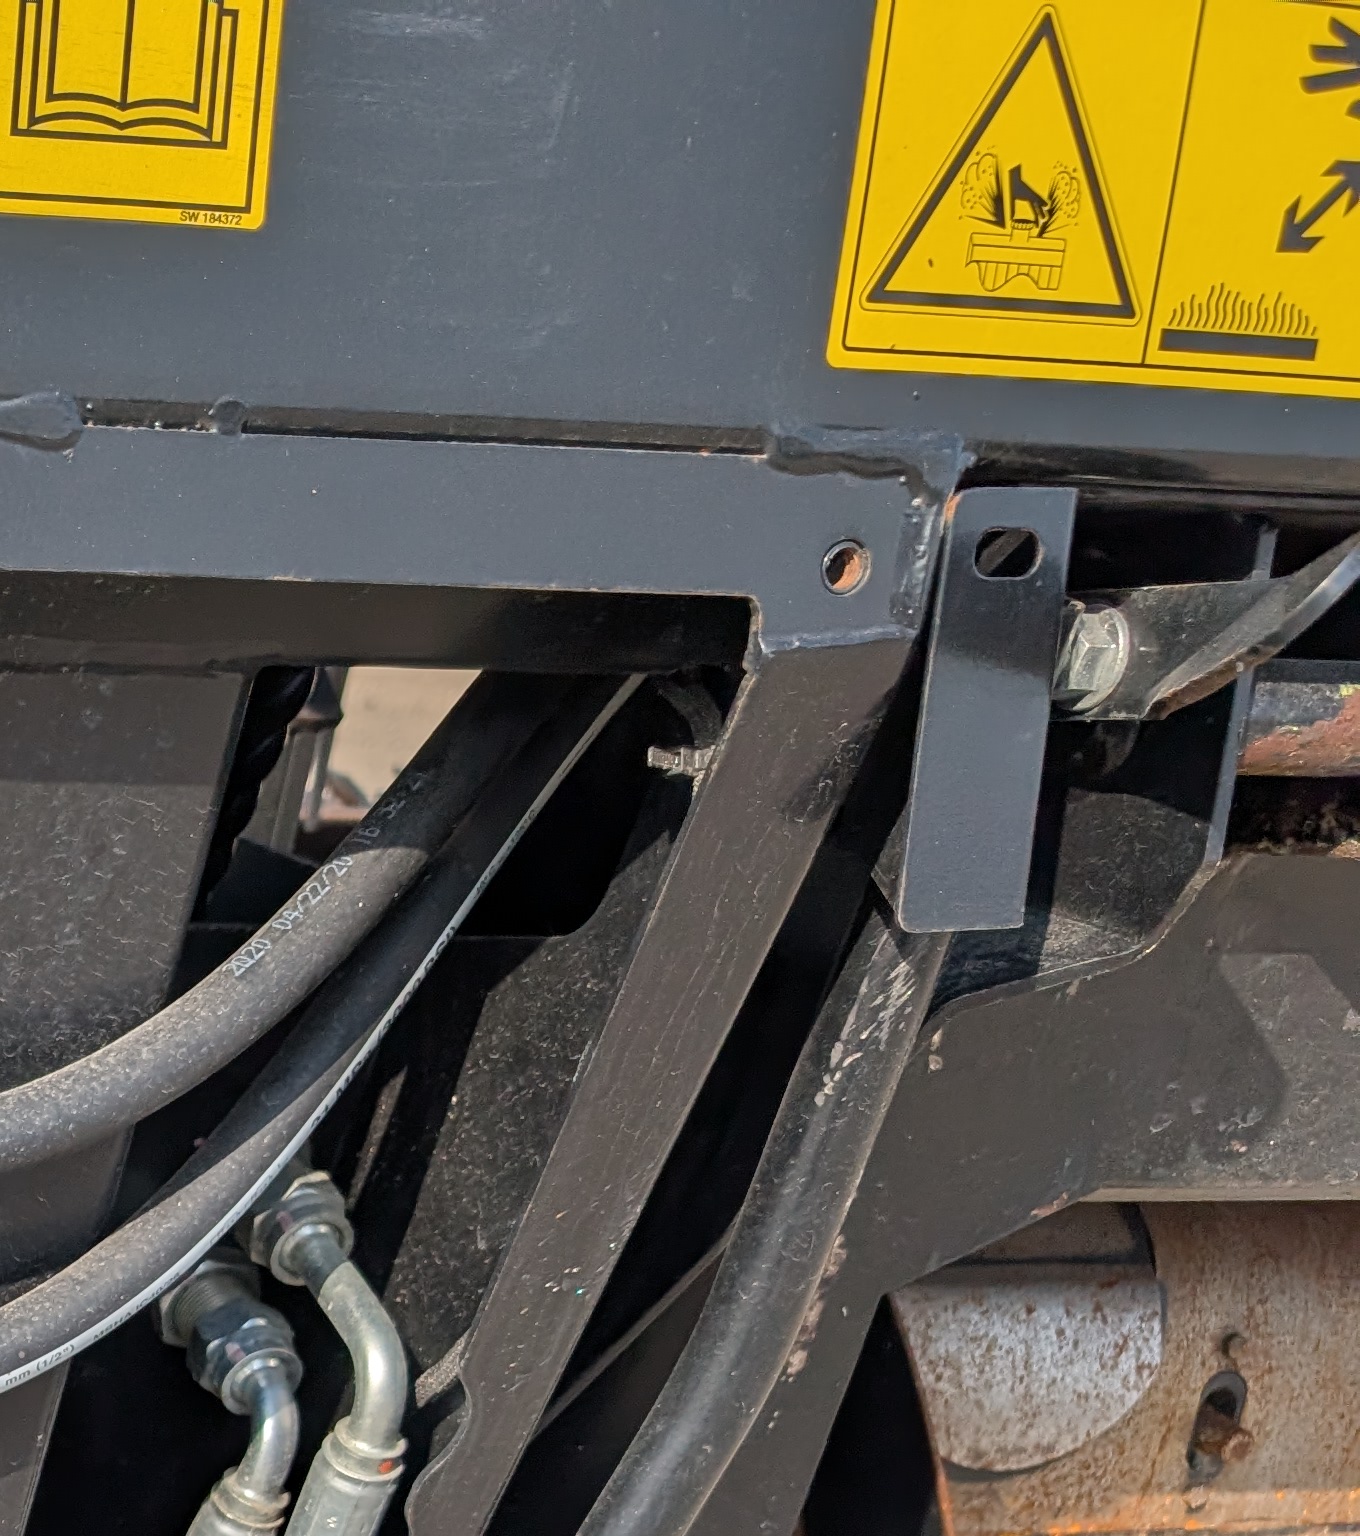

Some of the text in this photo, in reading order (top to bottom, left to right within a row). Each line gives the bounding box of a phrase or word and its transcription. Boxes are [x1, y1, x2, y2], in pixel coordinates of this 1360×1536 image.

[179, 210, 242, 226] SW 184372
[5, 1370, 31, 1387] mm
